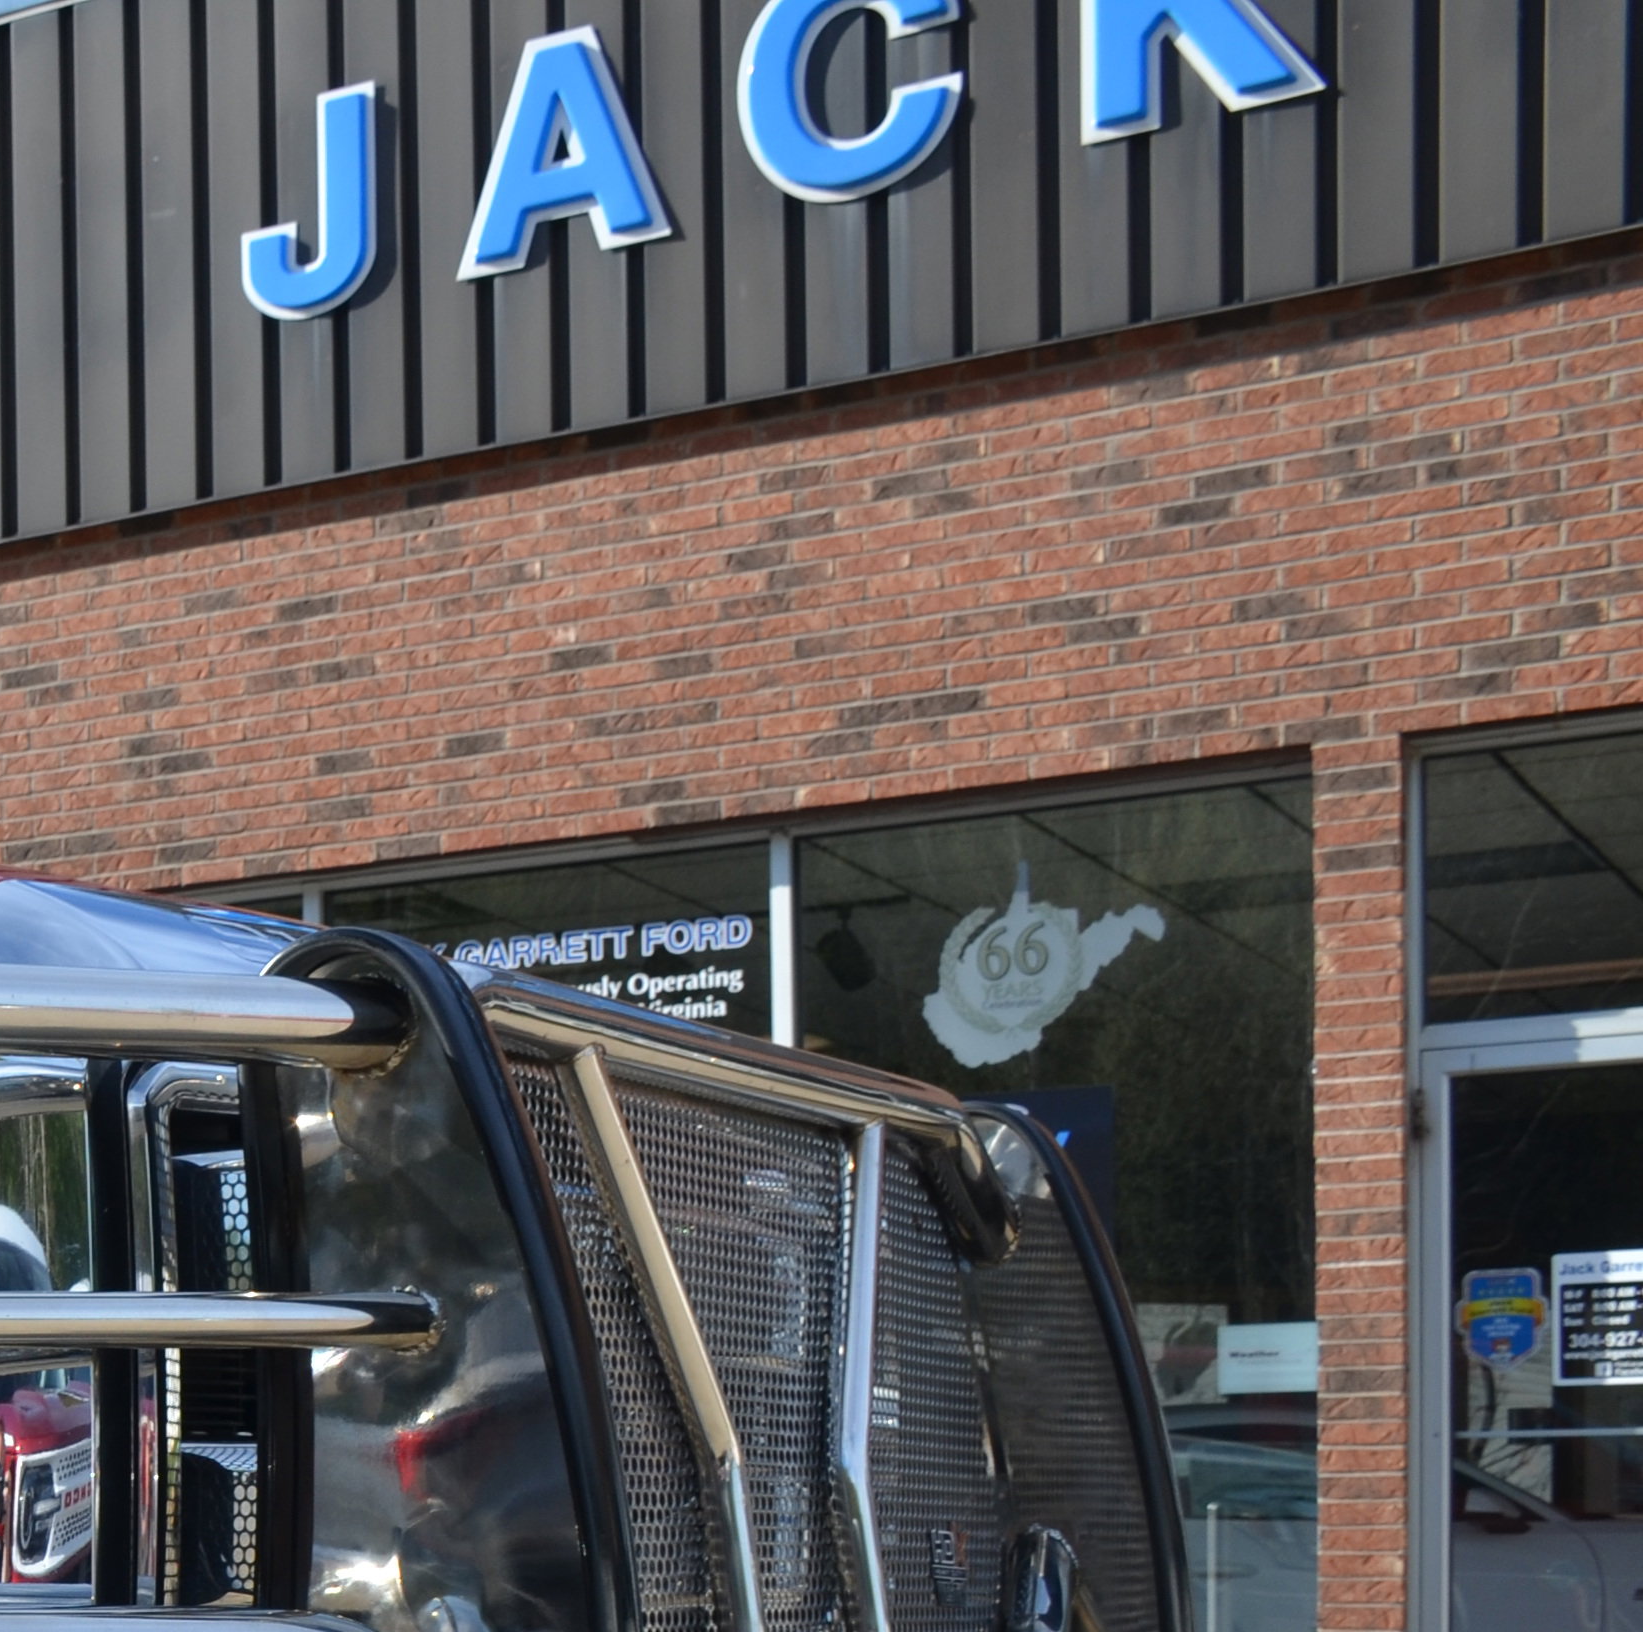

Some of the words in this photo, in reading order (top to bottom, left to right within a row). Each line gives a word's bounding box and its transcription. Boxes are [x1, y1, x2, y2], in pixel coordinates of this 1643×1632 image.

[241, 0, 1325, 320] JACK
[453, 925, 634, 970] GARRETT
[641, 914, 752, 957] FORD
[977, 920, 1049, 982] 66
[627, 967, 744, 998] Operating
[1559, 1263, 1595, 1276] Jack
